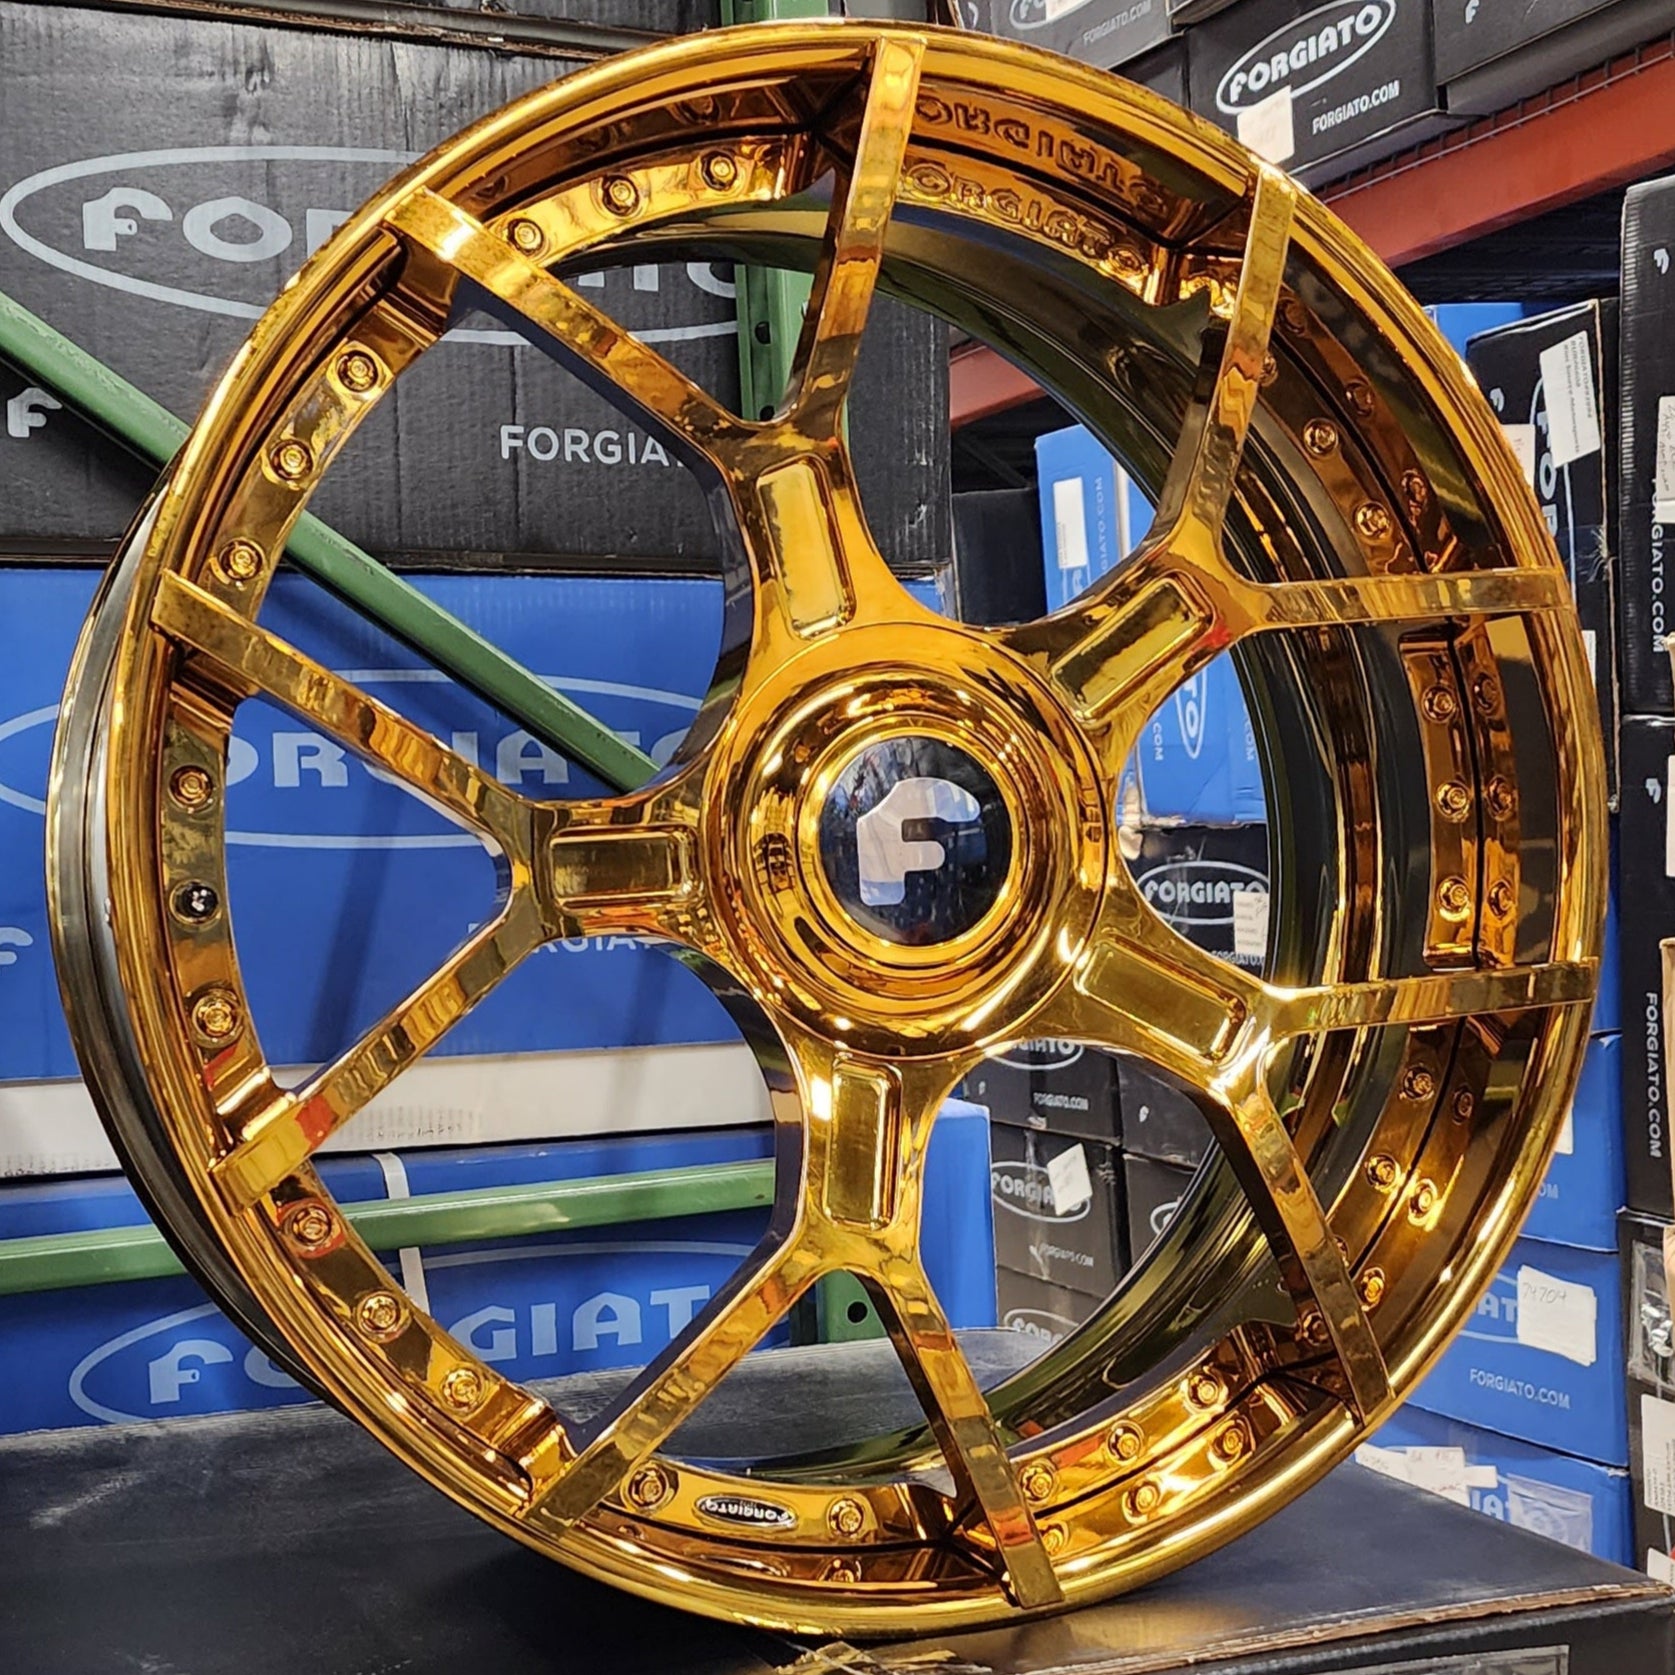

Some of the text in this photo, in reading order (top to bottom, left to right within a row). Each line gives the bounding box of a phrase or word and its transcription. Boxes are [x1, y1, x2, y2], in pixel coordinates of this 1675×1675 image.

[1230, 4, 1382, 104] FORGIATO
[1311, 80, 1400, 135] FORGIATO.COM
[500, 424, 685, 468] FORGIA
[1645, 992, 1663, 1158] FORGIATO.COM
[1469, 1367, 1571, 1410] FORGIATO.COM
